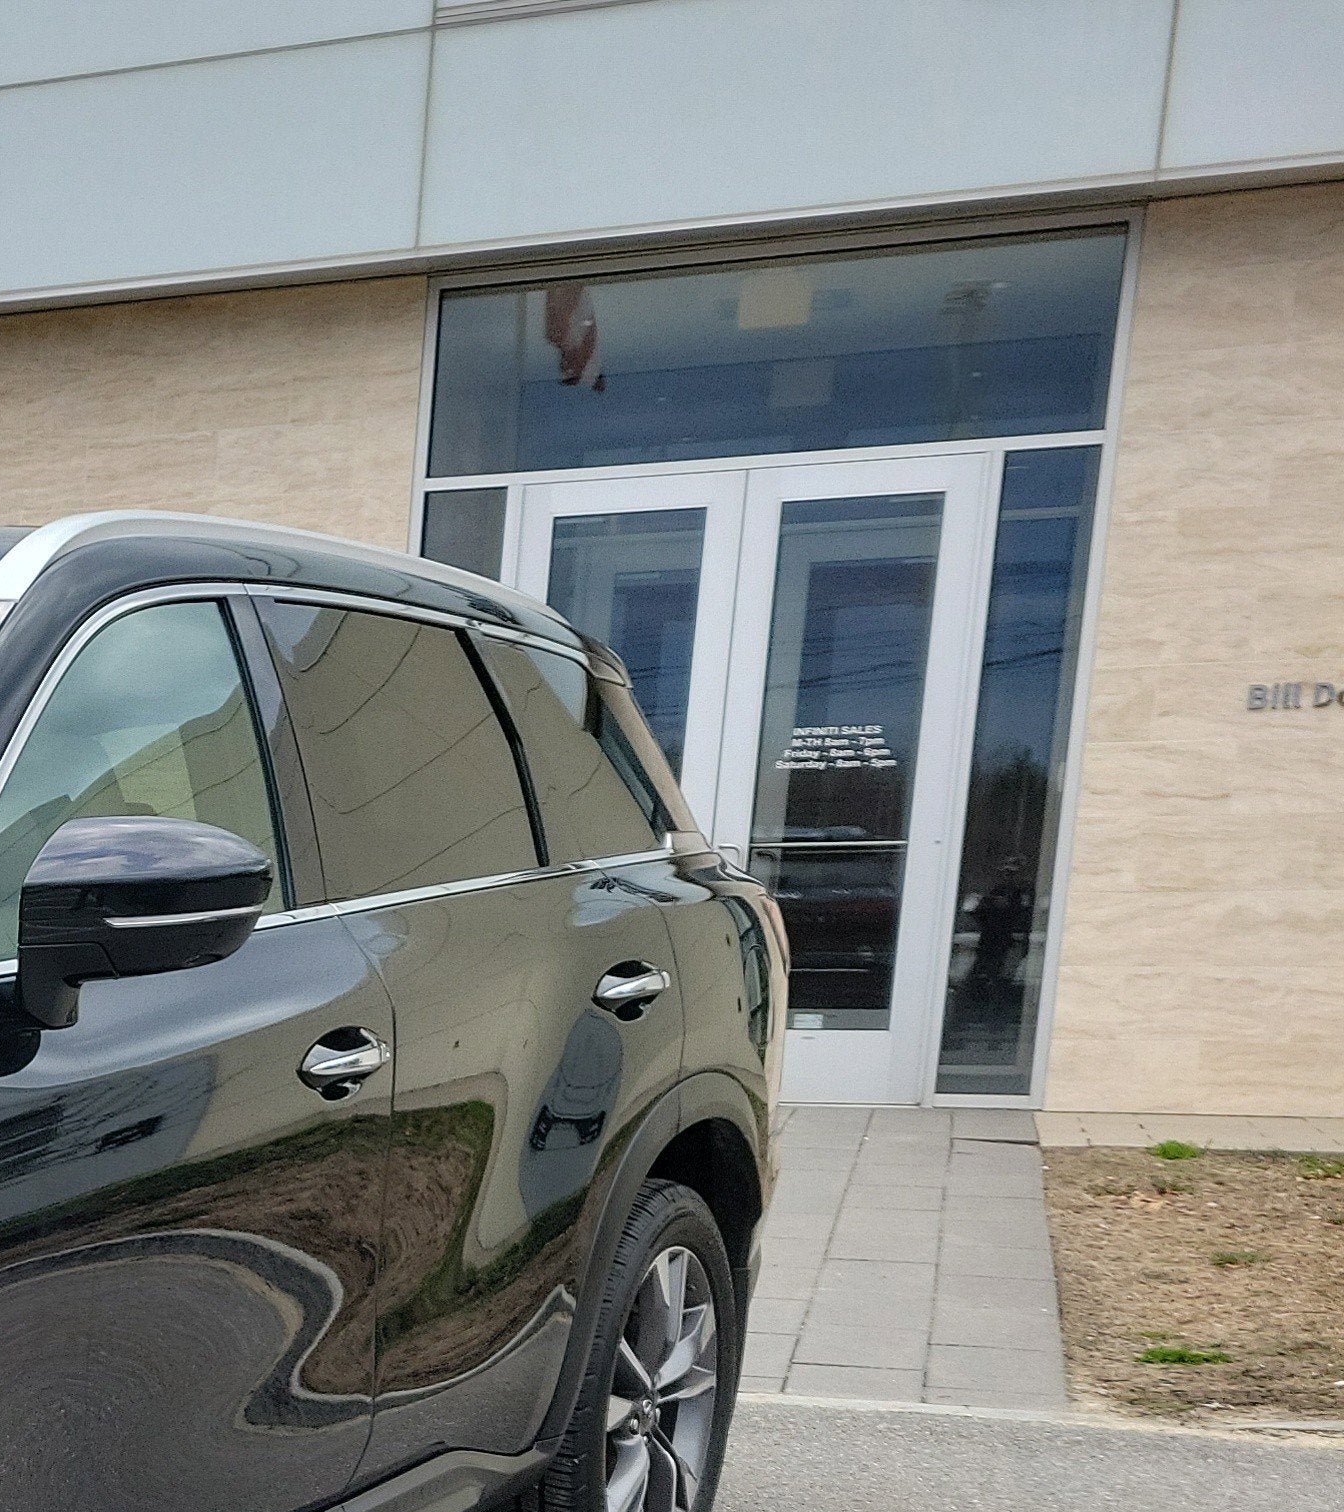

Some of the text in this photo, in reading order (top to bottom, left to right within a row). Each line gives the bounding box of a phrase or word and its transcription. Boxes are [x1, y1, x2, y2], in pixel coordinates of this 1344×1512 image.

[1247, 683, 1301, 710] Bill
[793, 725, 884, 736] INFINITI SALES
[784, 749, 821, 759] Friday
[775, 760, 827, 770] Saturday
